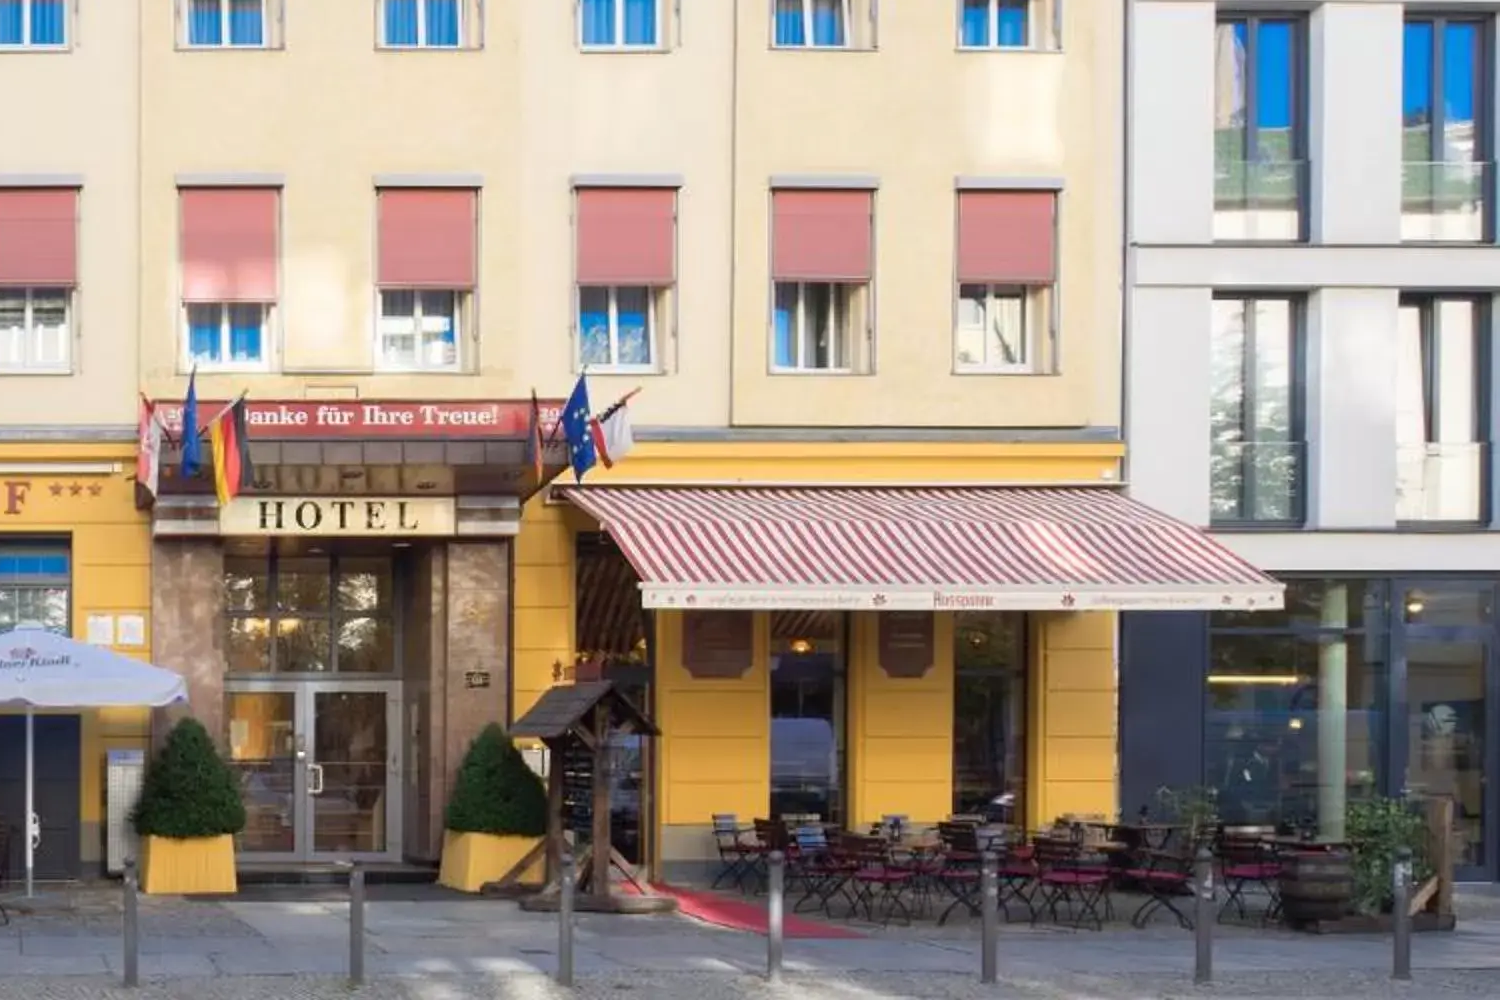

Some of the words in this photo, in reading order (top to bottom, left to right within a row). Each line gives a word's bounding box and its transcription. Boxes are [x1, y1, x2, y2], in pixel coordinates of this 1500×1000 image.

[244, 404, 309, 426] anke
[316, 404, 355, 426] für
[362, 405, 413, 426] Ihre
[420, 404, 498, 426] Treue!
[258, 501, 418, 530] HOTEL
